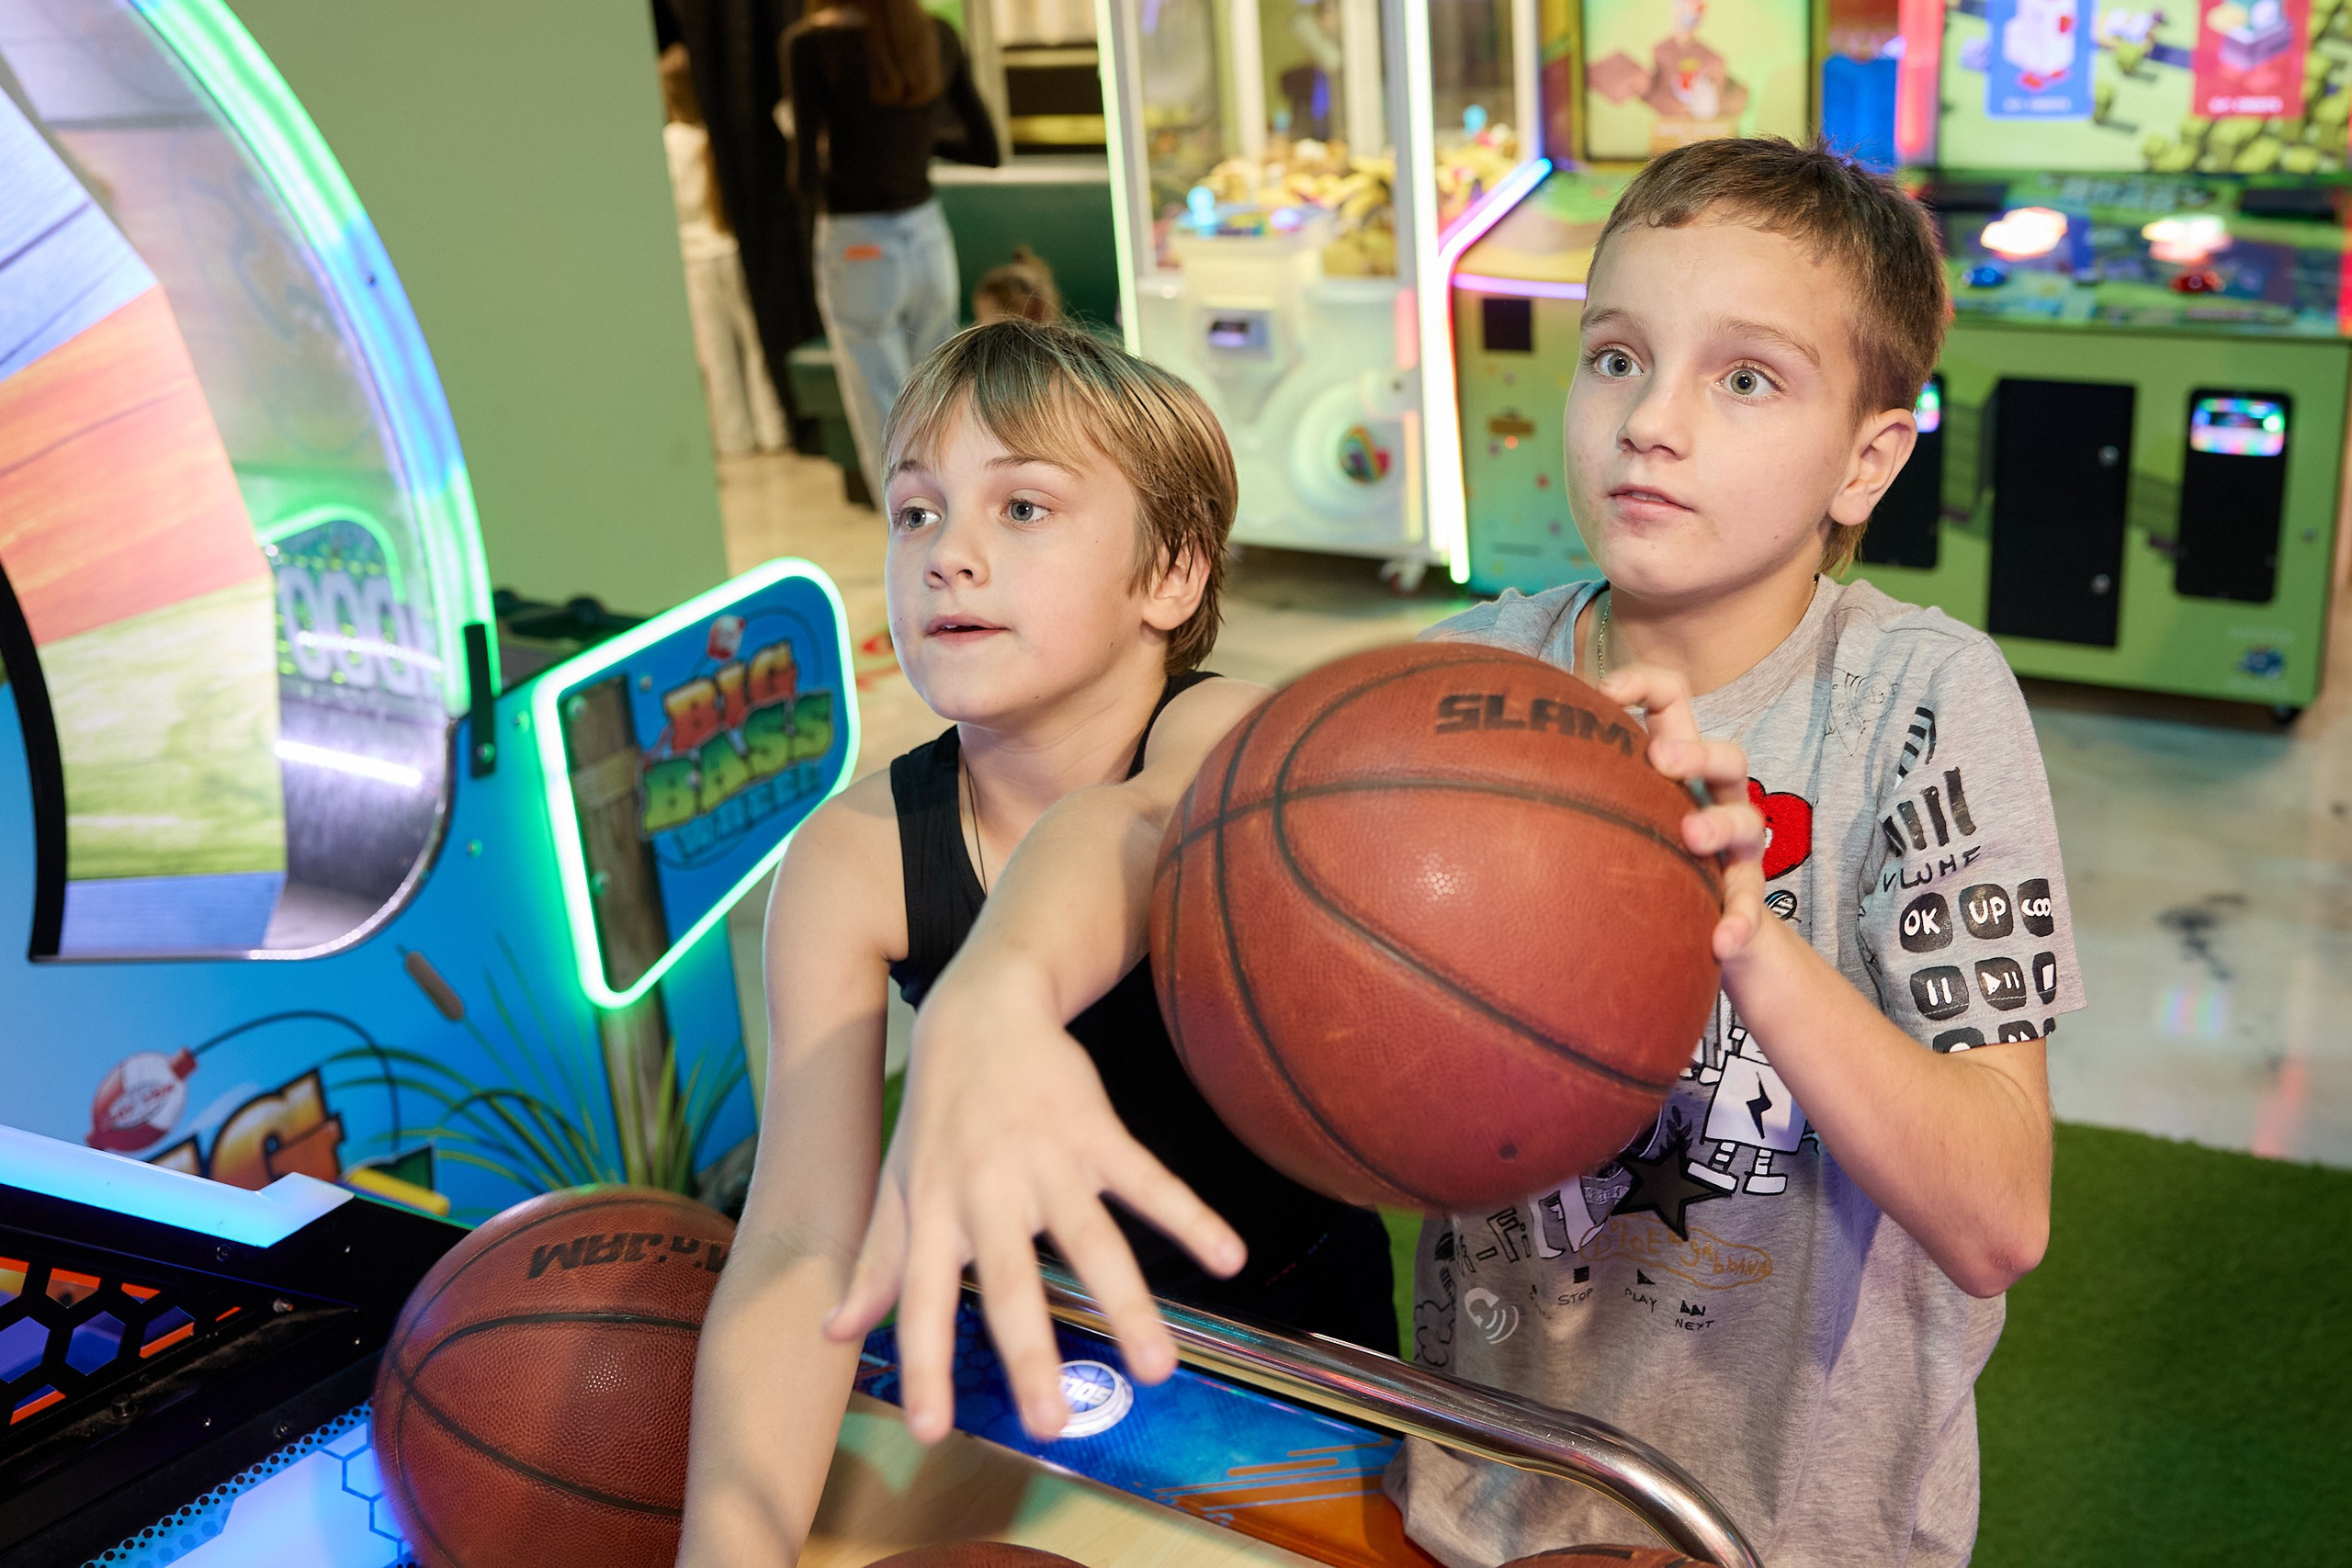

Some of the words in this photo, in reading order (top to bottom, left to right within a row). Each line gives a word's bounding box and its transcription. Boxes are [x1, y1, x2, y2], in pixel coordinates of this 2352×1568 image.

[663, 642, 797, 750] BIG
[1435, 694, 1636, 756] SLAM
[643, 693, 833, 832] BASS
[1904, 908, 1941, 937] OK
[1968, 896, 2007, 925] UP
[1557, 1288, 1594, 1305] STOP
[1624, 1288, 1658, 1313] PLAY
[1675, 1318, 1715, 1331] NEXT
